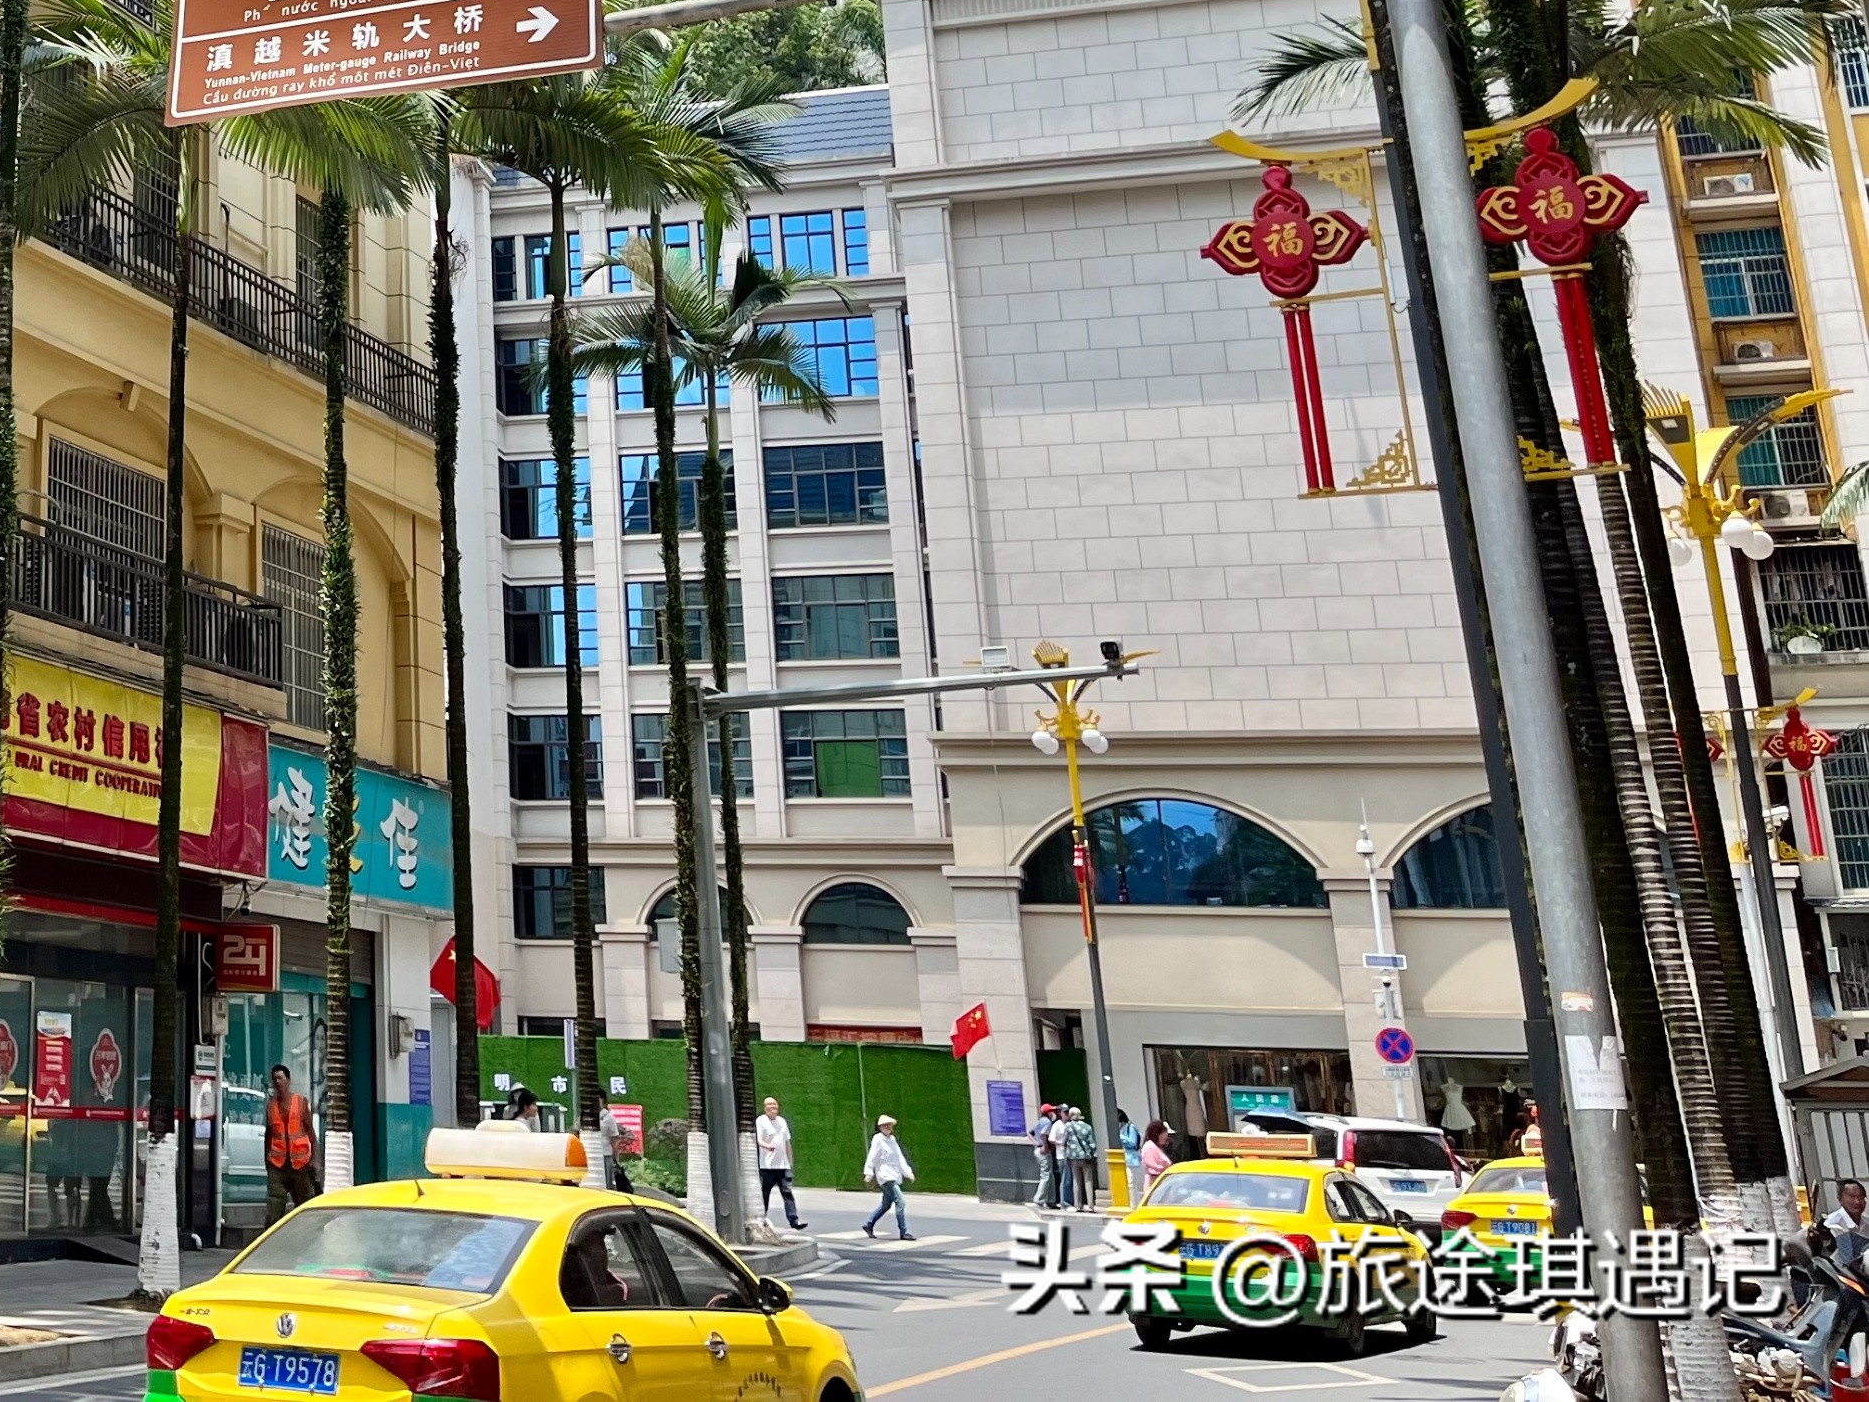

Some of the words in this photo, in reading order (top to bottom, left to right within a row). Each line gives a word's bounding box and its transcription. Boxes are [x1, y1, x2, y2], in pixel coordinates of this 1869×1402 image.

[206, 4, 484, 72] 滇越米轨大桥
[204, 67, 296, 89] Yunnan-Vietnam
[303, 56, 377, 75] Meter-gauge
[383, 48, 432, 63] Railway
[438, 40, 481, 56] Bridge
[282, 81, 305, 94] ray
[1528, 187, 1575, 222] 福
[1261, 223, 1304, 257] 福
[49, 754, 89, 783] CREDIT
[268, 766, 418, 888] 健佳
